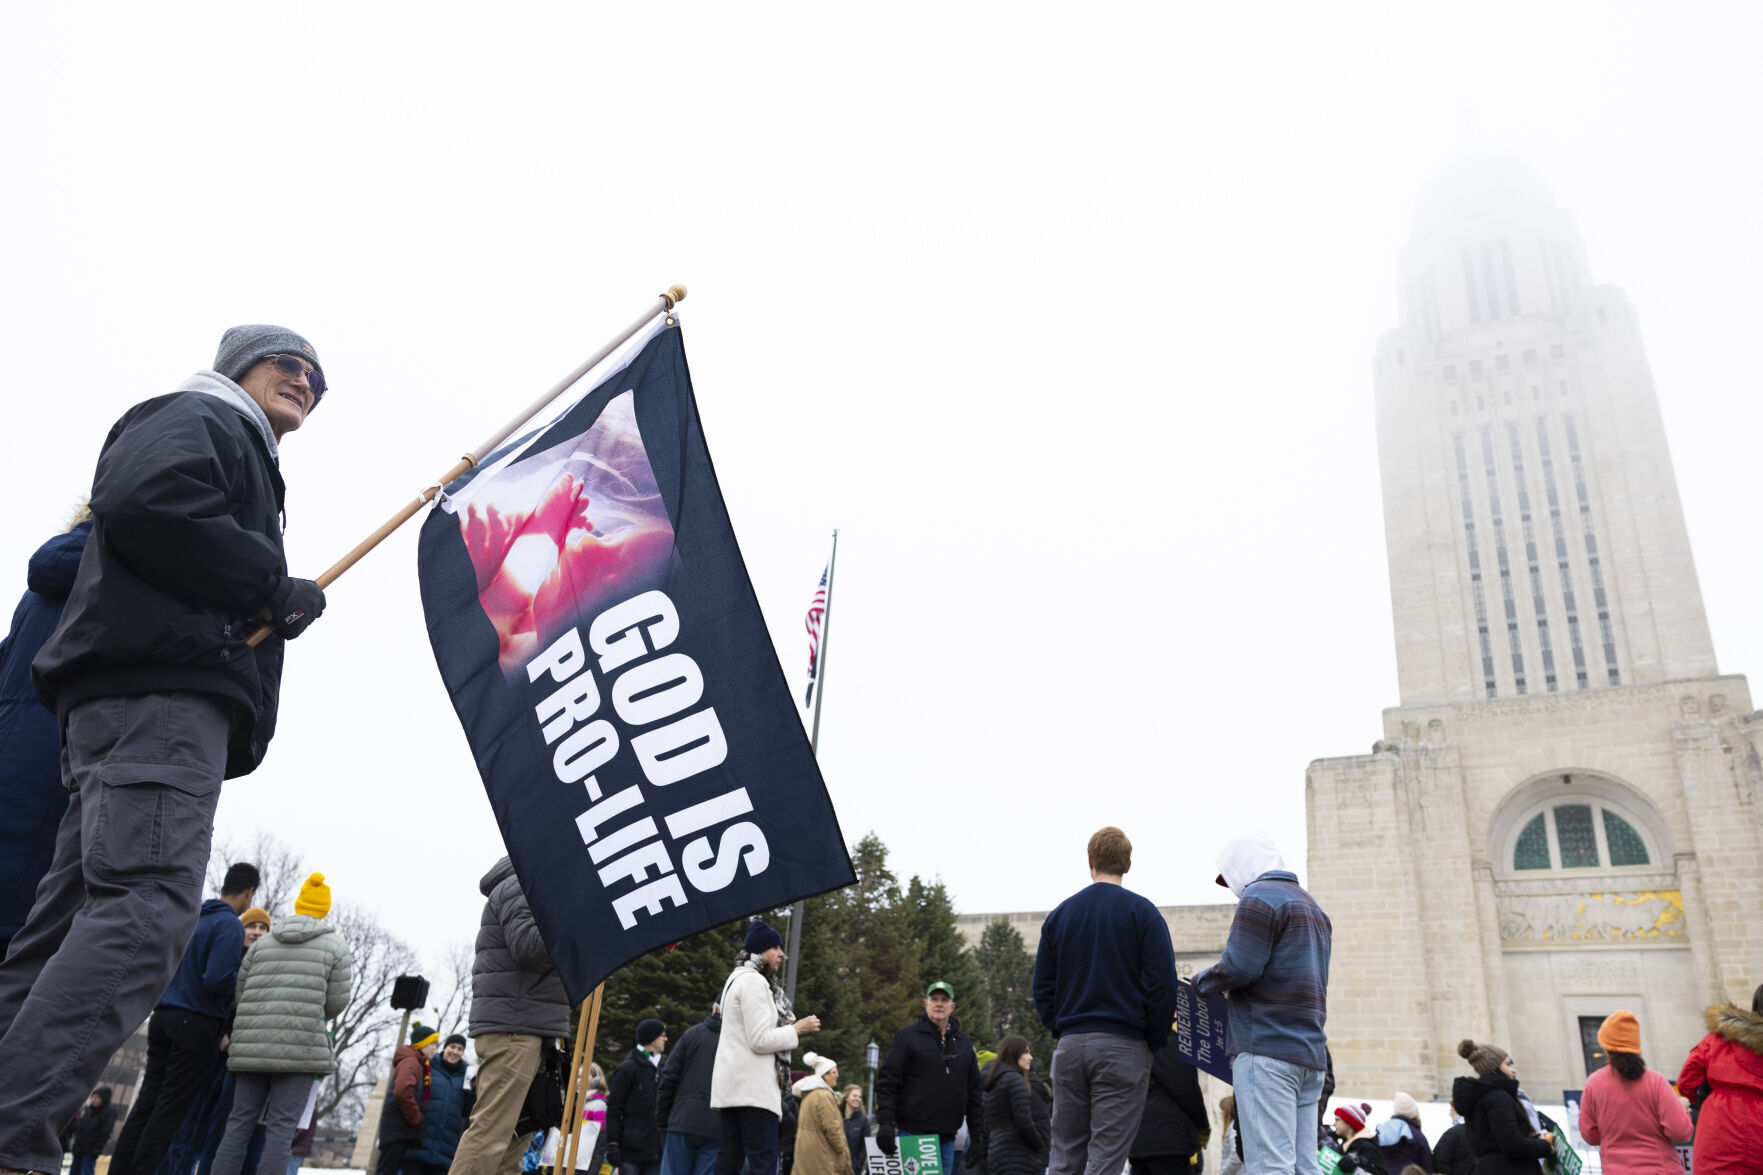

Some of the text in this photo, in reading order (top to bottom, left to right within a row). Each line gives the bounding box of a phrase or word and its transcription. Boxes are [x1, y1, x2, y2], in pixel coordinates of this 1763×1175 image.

[589, 590, 769, 892] GOD IS
[526, 627, 688, 930] PRO-LIFE
[1196, 998, 1212, 1064] The Unbor
[918, 1138, 938, 1167] LOVE
[1320, 1149, 1340, 1175] LIFE
